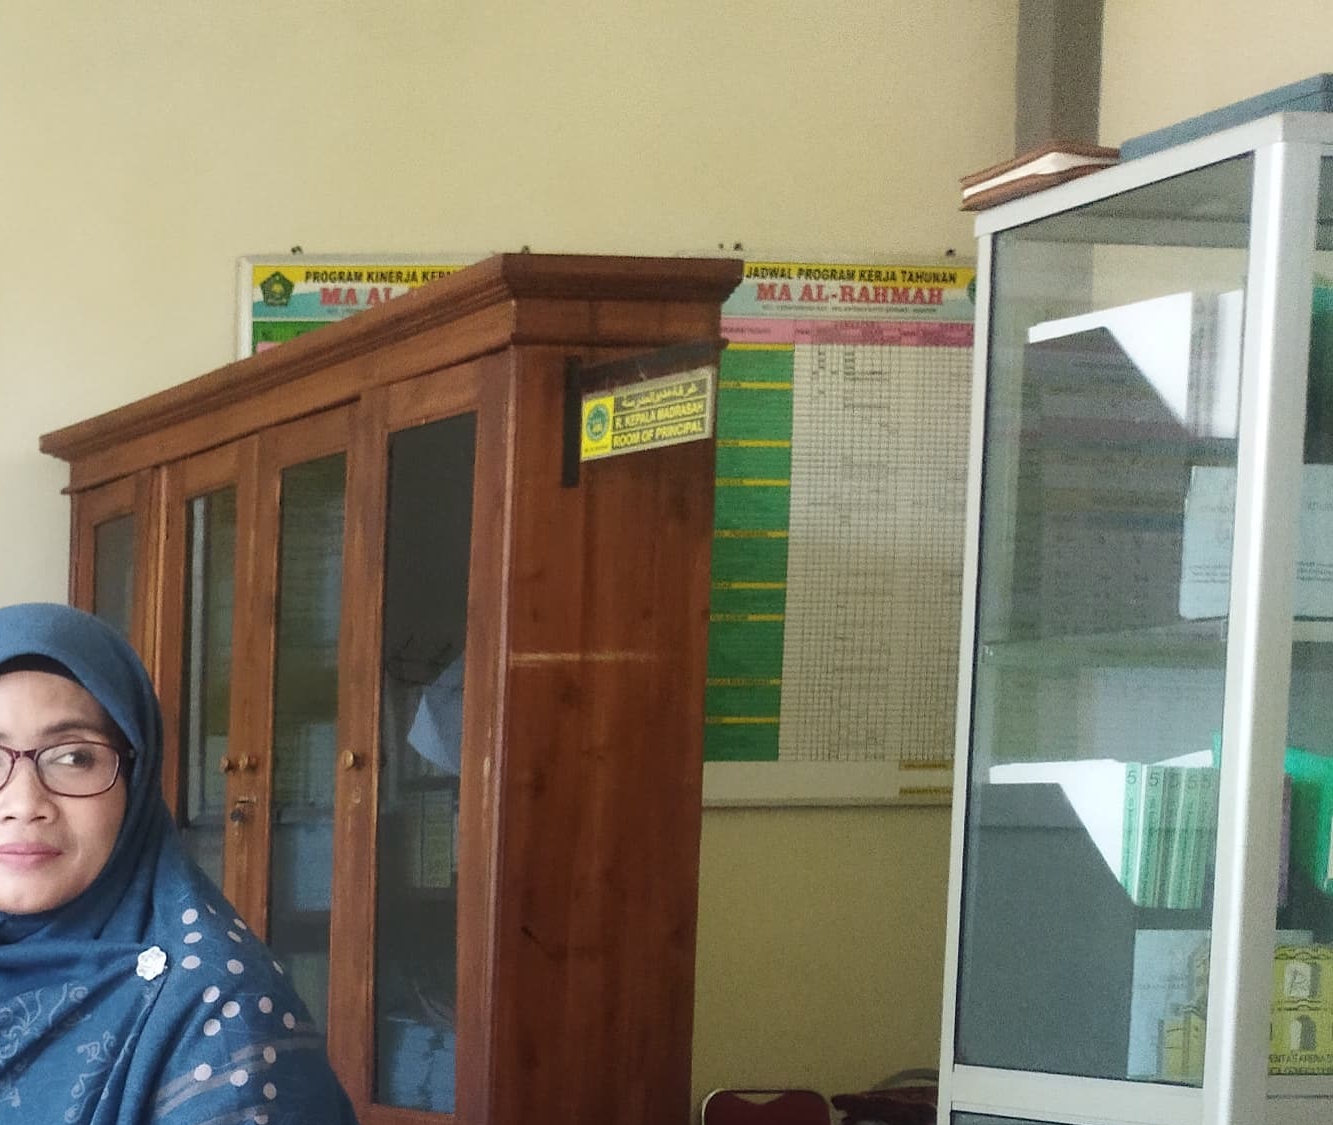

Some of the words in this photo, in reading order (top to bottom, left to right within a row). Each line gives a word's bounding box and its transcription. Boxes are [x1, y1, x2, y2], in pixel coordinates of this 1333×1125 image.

[305, 271, 363, 284] PROGRAM
[366, 271, 418, 284] KINERJA
[746, 266, 794, 280] JADWAL
[797, 267, 855, 282] PROGRAM
[858, 268, 898, 283] KERJA
[901, 270, 958, 285] TAHUNAN
[319, 287, 358, 306] MA
[757, 283, 795, 302] MA
[799, 283, 944, 305] AL-RAHMAH
[625, 408, 656, 426] KEPALA
[657, 400, 705, 421] MADRASAH
[613, 434, 640, 447] ROOM
[641, 429, 654, 443] OF
[655, 420, 703, 440] PRINCIPAL
